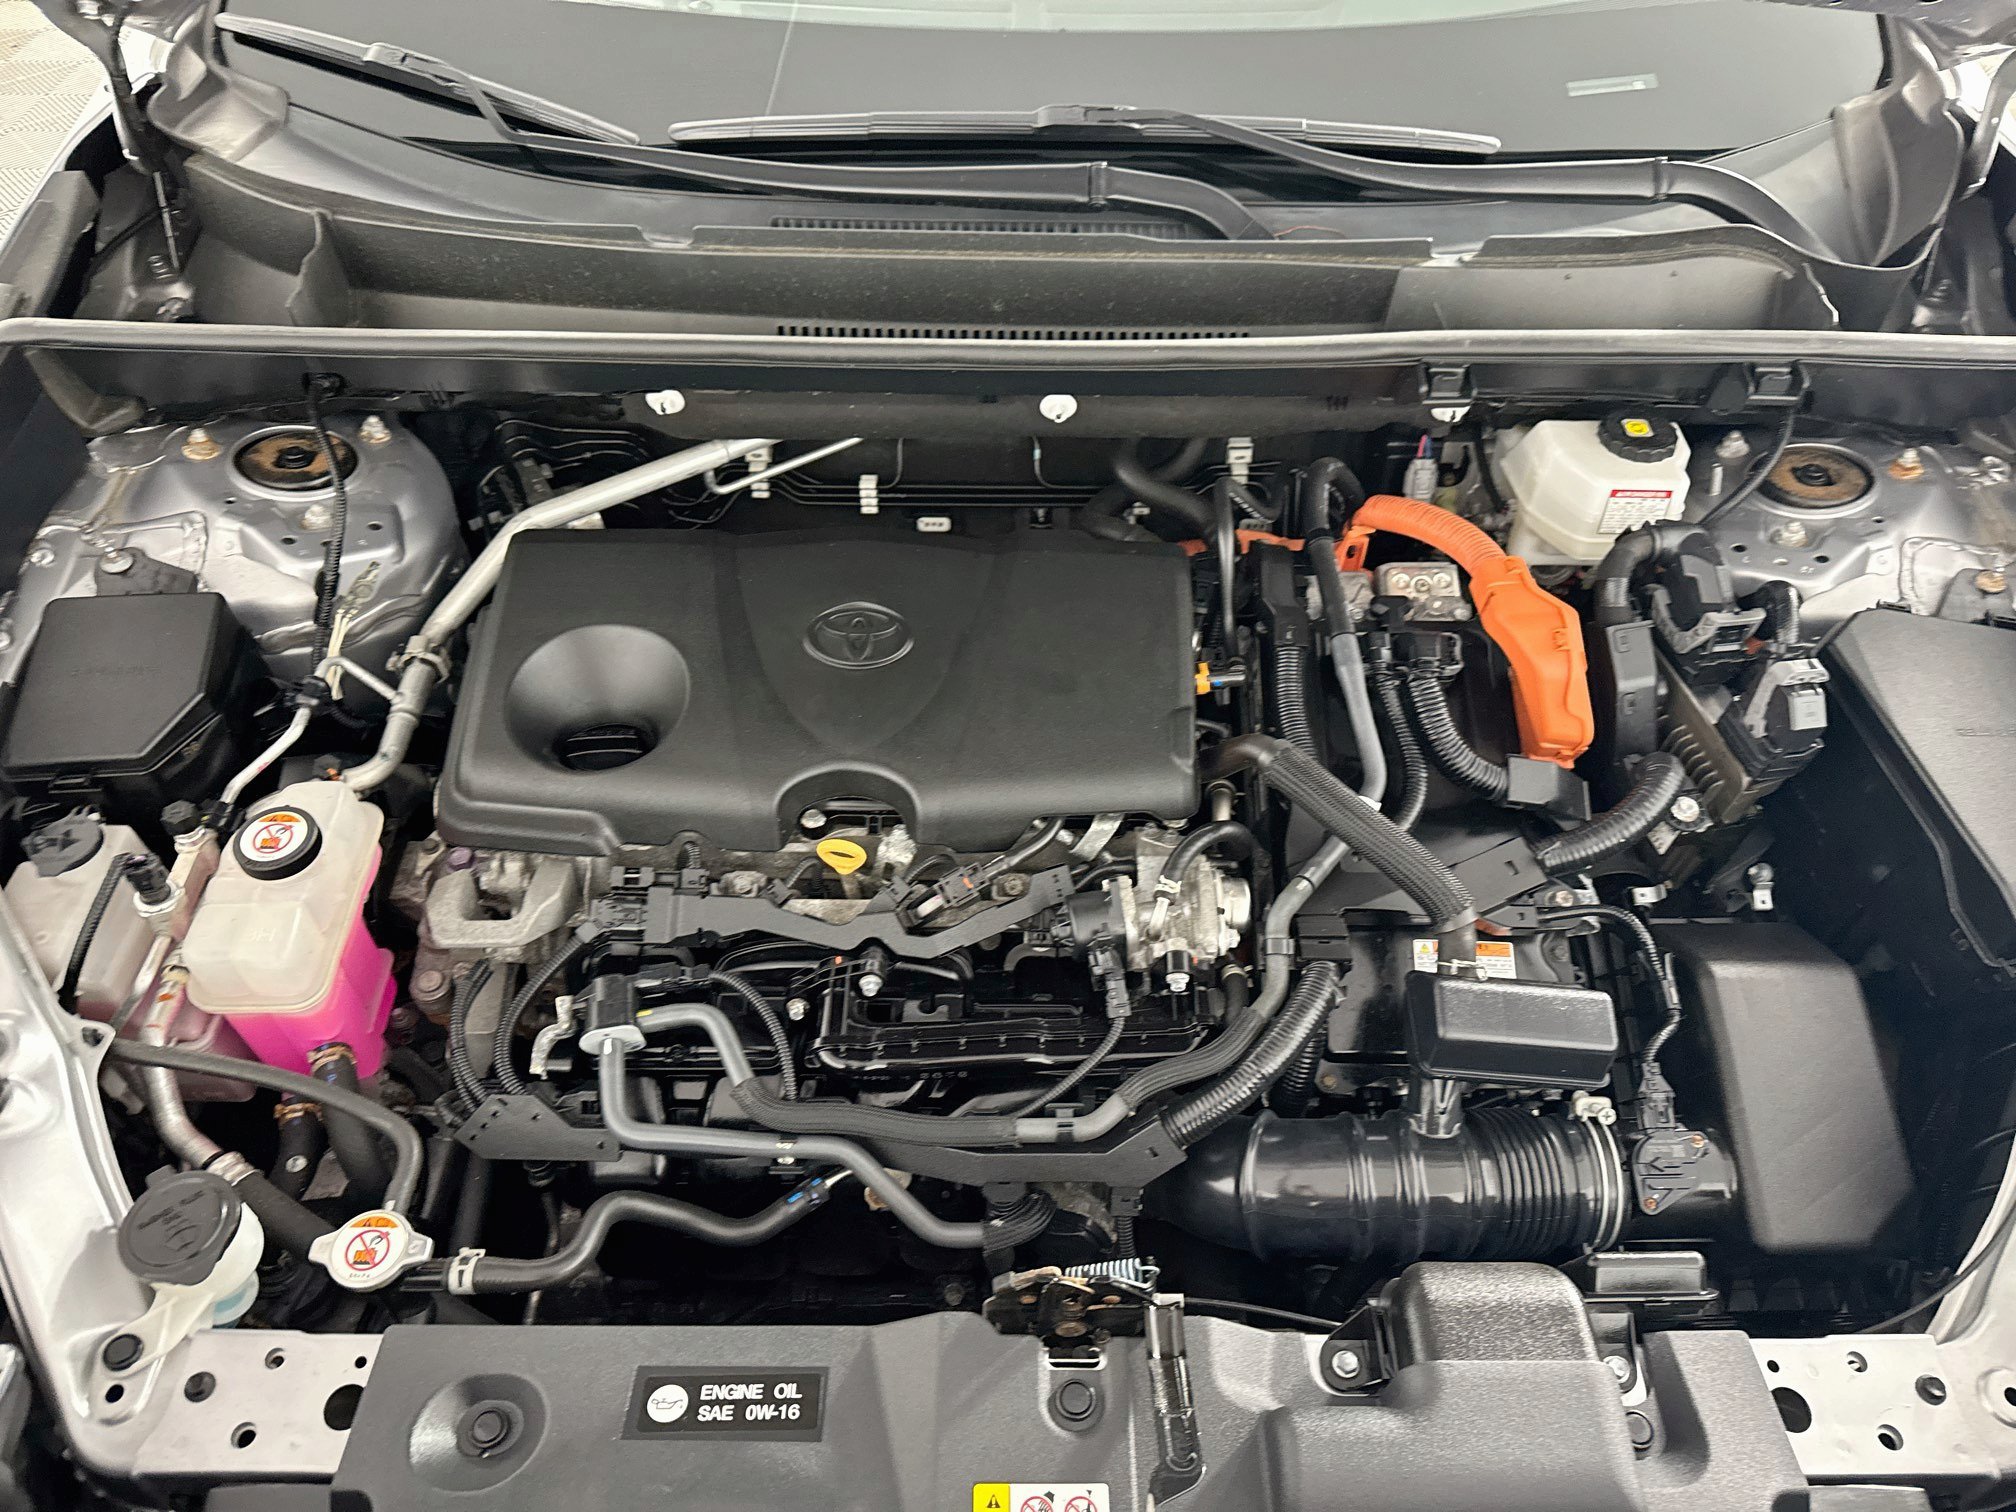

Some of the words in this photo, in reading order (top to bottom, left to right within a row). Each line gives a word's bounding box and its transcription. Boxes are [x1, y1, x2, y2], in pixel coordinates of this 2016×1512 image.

[700, 1384, 765, 1400] ENGINE
[774, 1383, 803, 1399] OIL
[697, 1405, 735, 1421] SAE
[745, 1404, 801, 1420] 0W-16
